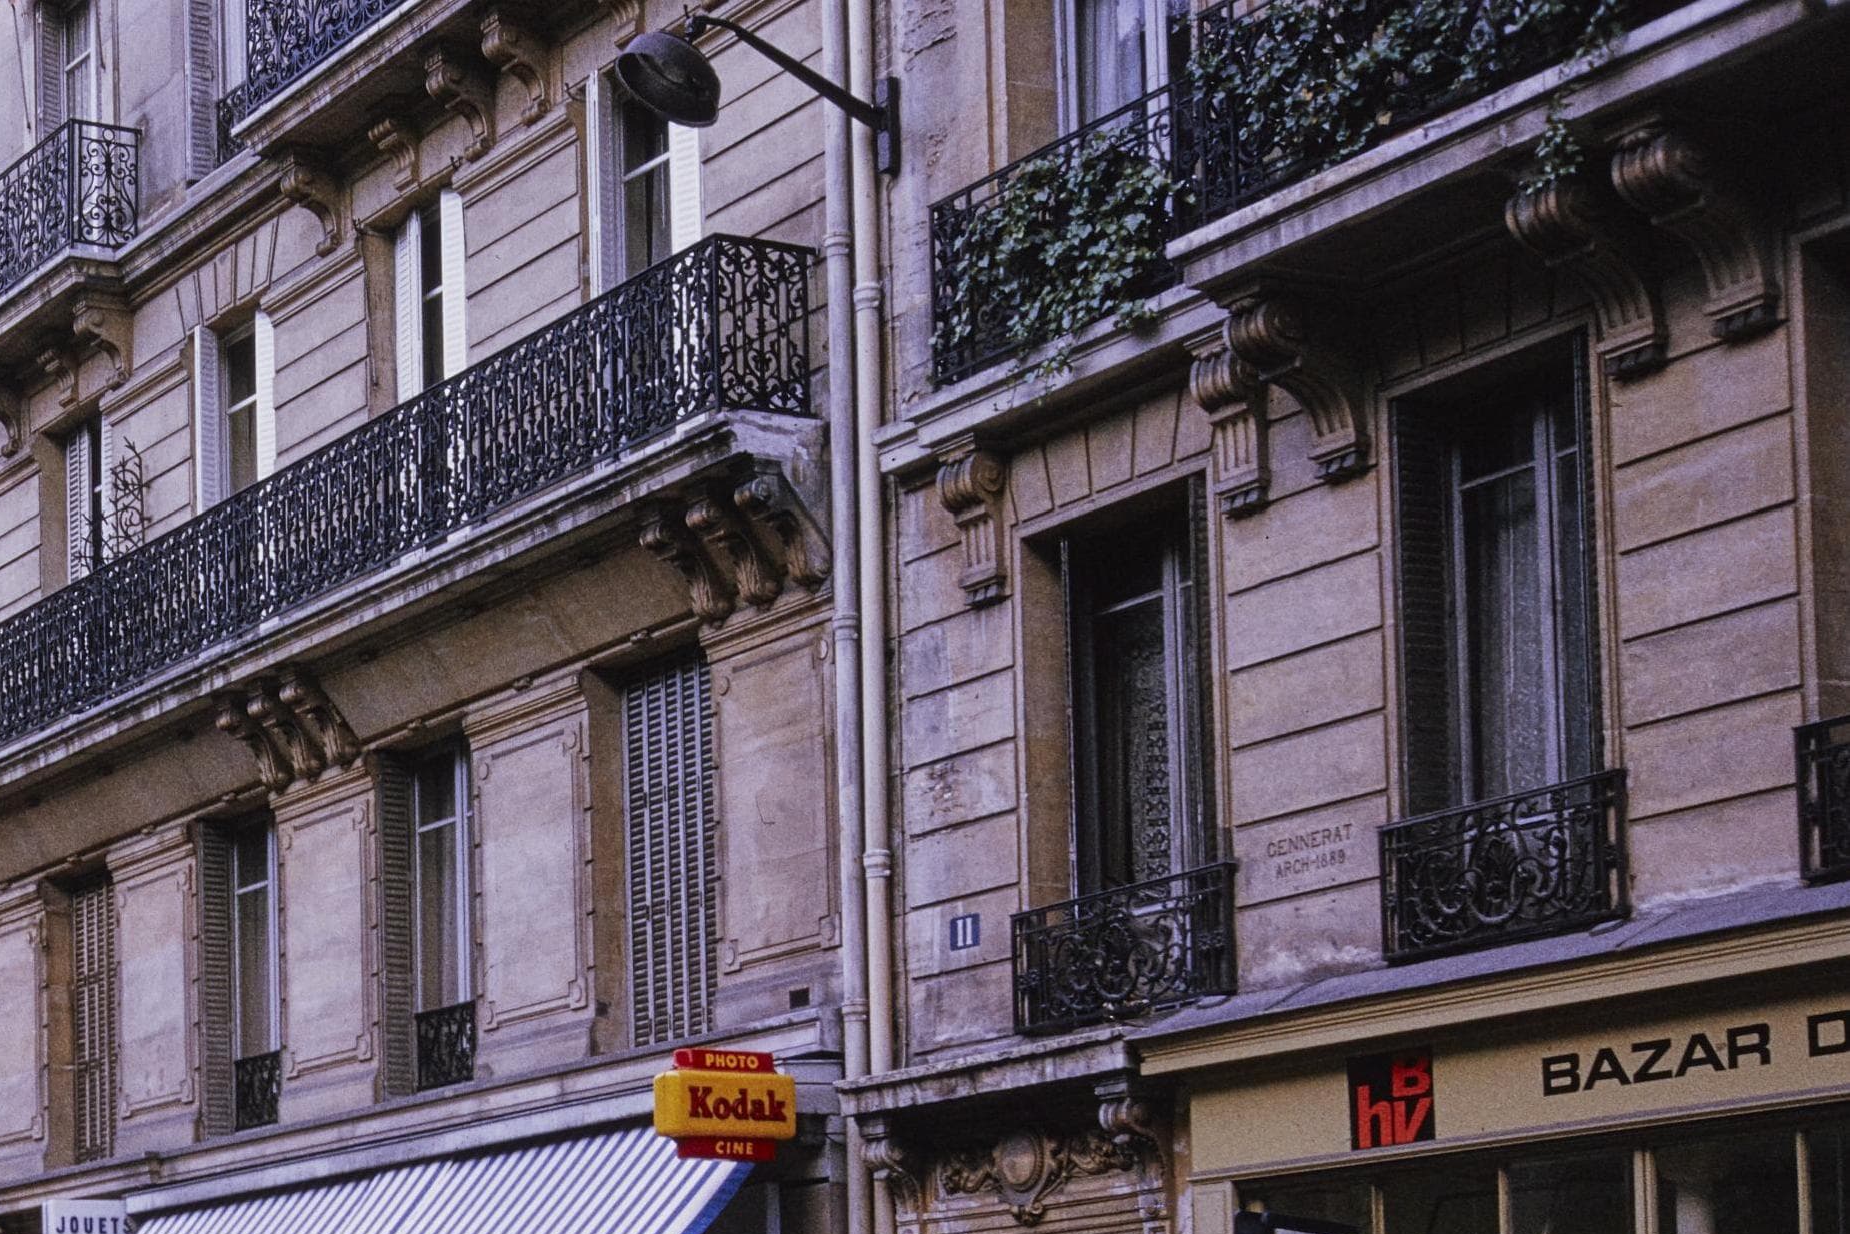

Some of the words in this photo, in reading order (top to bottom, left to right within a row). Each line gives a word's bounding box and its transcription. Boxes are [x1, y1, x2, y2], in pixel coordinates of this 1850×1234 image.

[705, 1053, 759, 1069] PHOTO
[1541, 1022, 1772, 1097] BAZAR
[687, 1085, 788, 1123] Kodak
[715, 1140, 754, 1155] CINE
